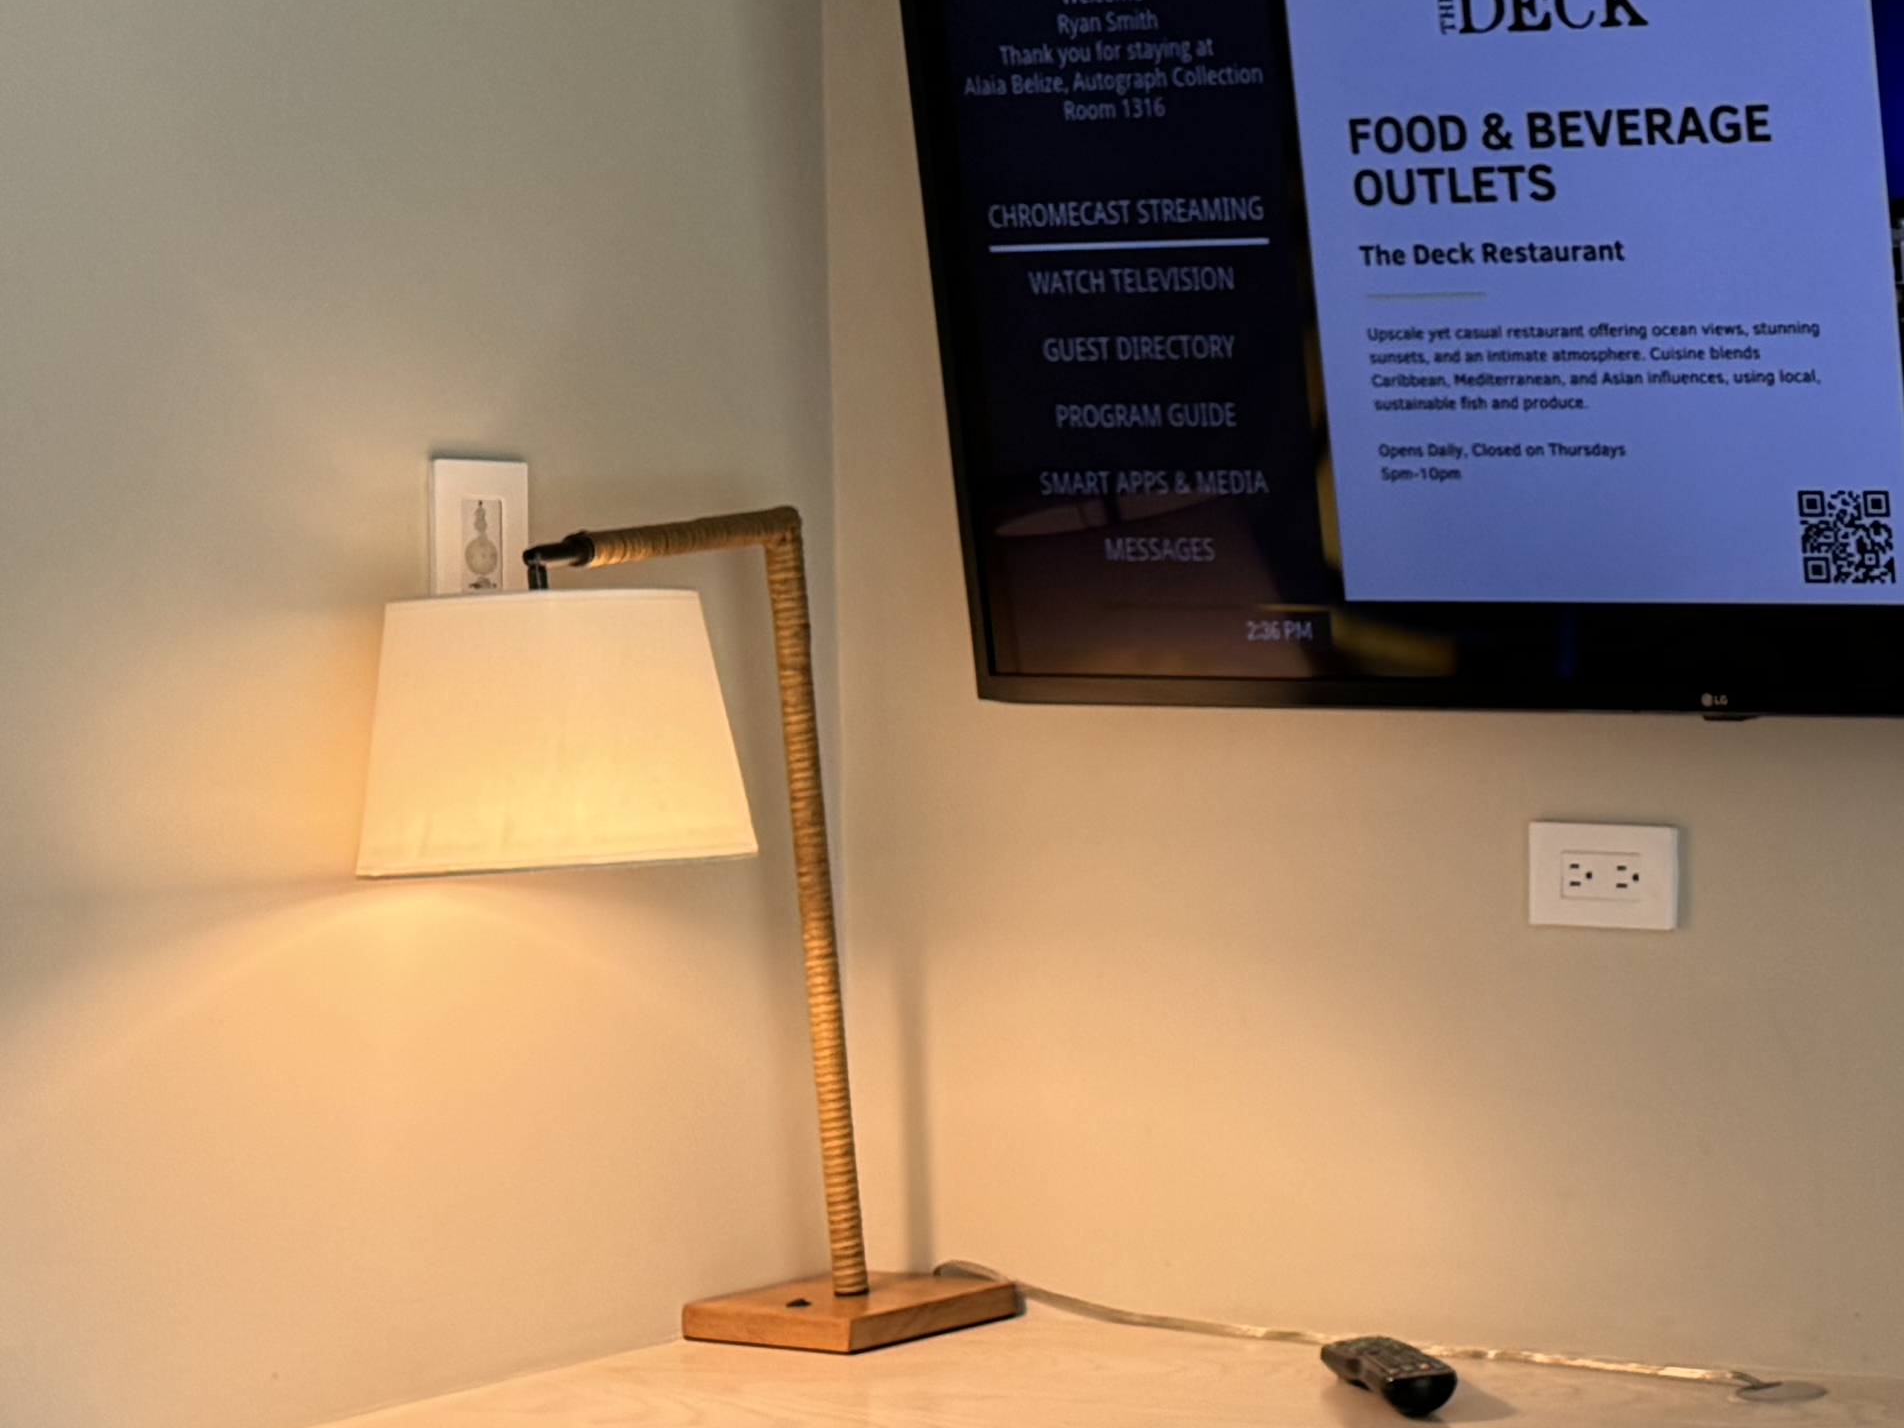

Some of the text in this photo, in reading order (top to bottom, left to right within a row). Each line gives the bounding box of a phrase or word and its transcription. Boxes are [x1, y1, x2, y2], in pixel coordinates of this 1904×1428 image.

[1057, 9, 1159, 39] Ryan Smith
[999, 37, 1214, 69] Thank you for staying at
[1011, 73, 1069, 95] Belize,
[1072, 68, 1168, 95] Autograph
[1172, 64, 1264, 88] Collection
[1063, 97, 1167, 121] Room 1316
[1349, 104, 1772, 154] FOOD & BEVERAGE
[1354, 165, 1556, 206] OUTLETS
[988, 196, 1264, 228] CHROMECAST STREAMING
[1360, 240, 1625, 266] The Deck Restaurant
[1028, 267, 1234, 294] WATCH TELEVISION
[1367, 321, 1820, 342] Upscale yet casual restaurant offering ocean views, stunning
[1043, 335, 1235, 362] GUEST DIRECTORY
[1369, 346, 1760, 365] sunsets, and an intimate atmosphere. Cuisine blends
[1371, 369, 1821, 389] Caribbean, Mediterranean, and Asian influences, using local,
[1055, 402, 1237, 428] PROGRAM GUIDE
[1374, 396, 1588, 412] sustainable fish and produce.
[1378, 442, 1626, 459] Opens Daily, Closed on Thursdays
[1040, 470, 1269, 495] SMART APPS & MEDIA
[1381, 467, 1461, 482] 5pm-10pm
[1105, 538, 1215, 562] MESSAGES
[1246, 621, 1313, 641] 2:36 PM
